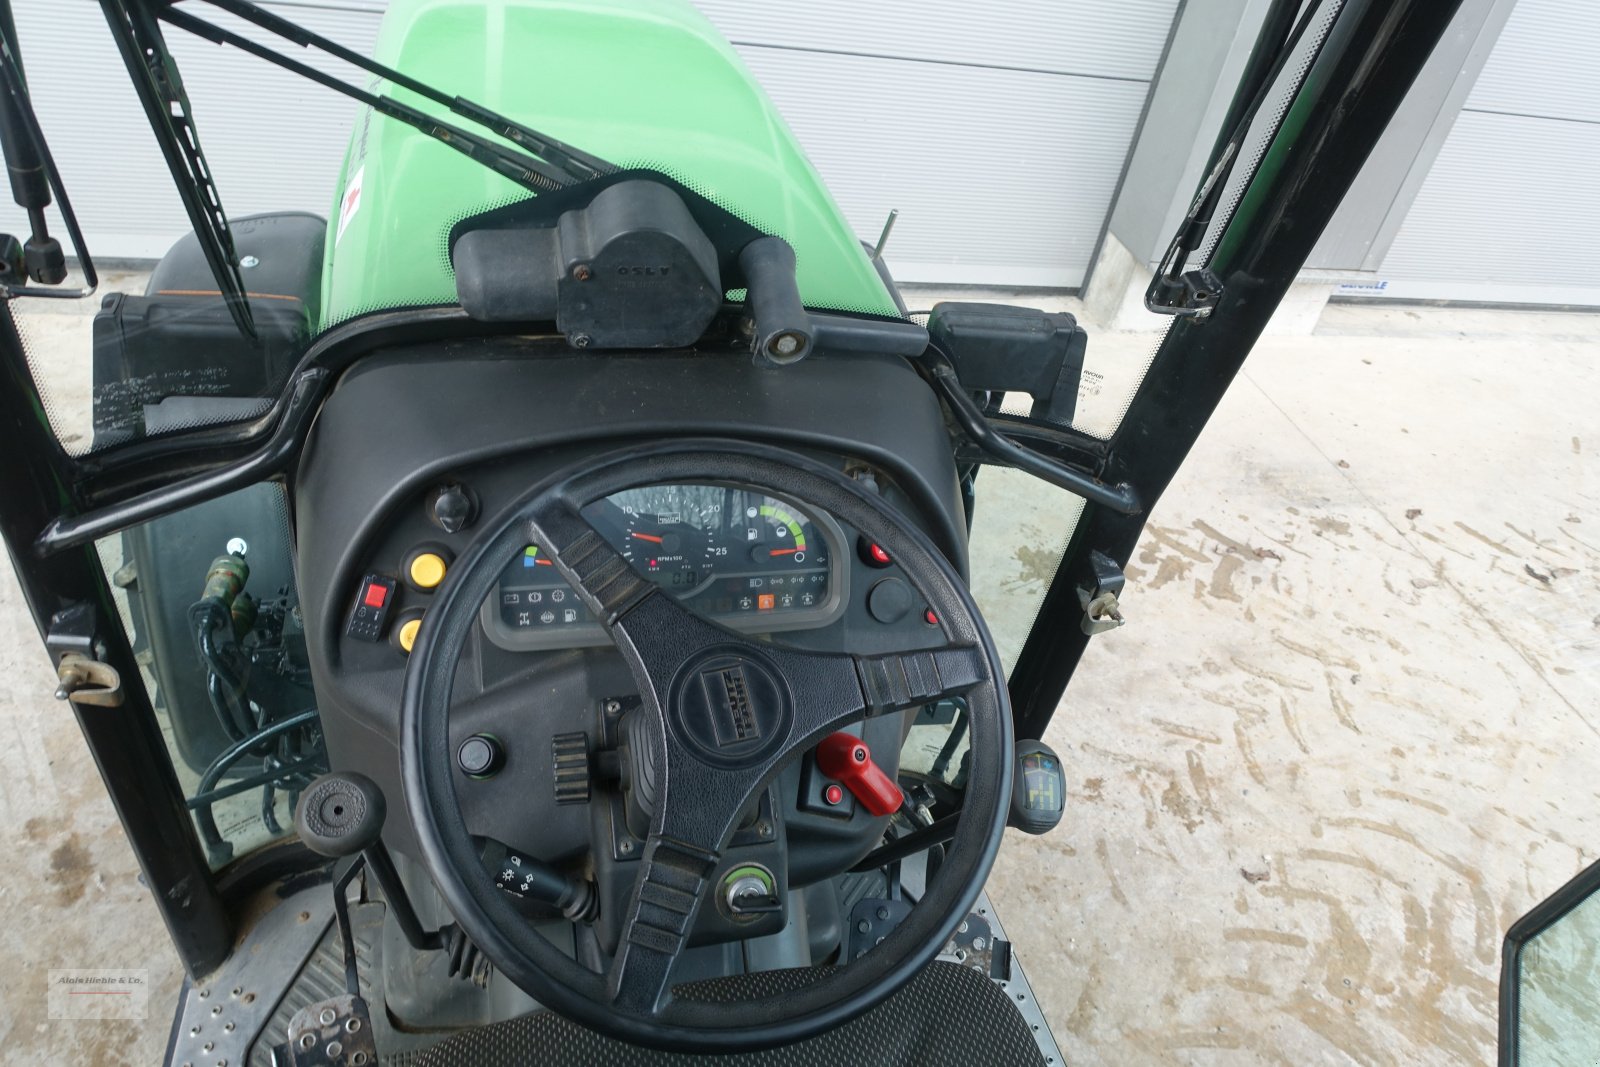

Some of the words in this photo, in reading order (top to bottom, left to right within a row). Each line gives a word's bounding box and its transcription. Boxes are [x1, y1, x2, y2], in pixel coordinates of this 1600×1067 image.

[622, 505, 633, 515] 10
[708, 505, 720, 513] 20
[715, 547, 728, 556] 25
[722, 670, 746, 739] DEUTZ
